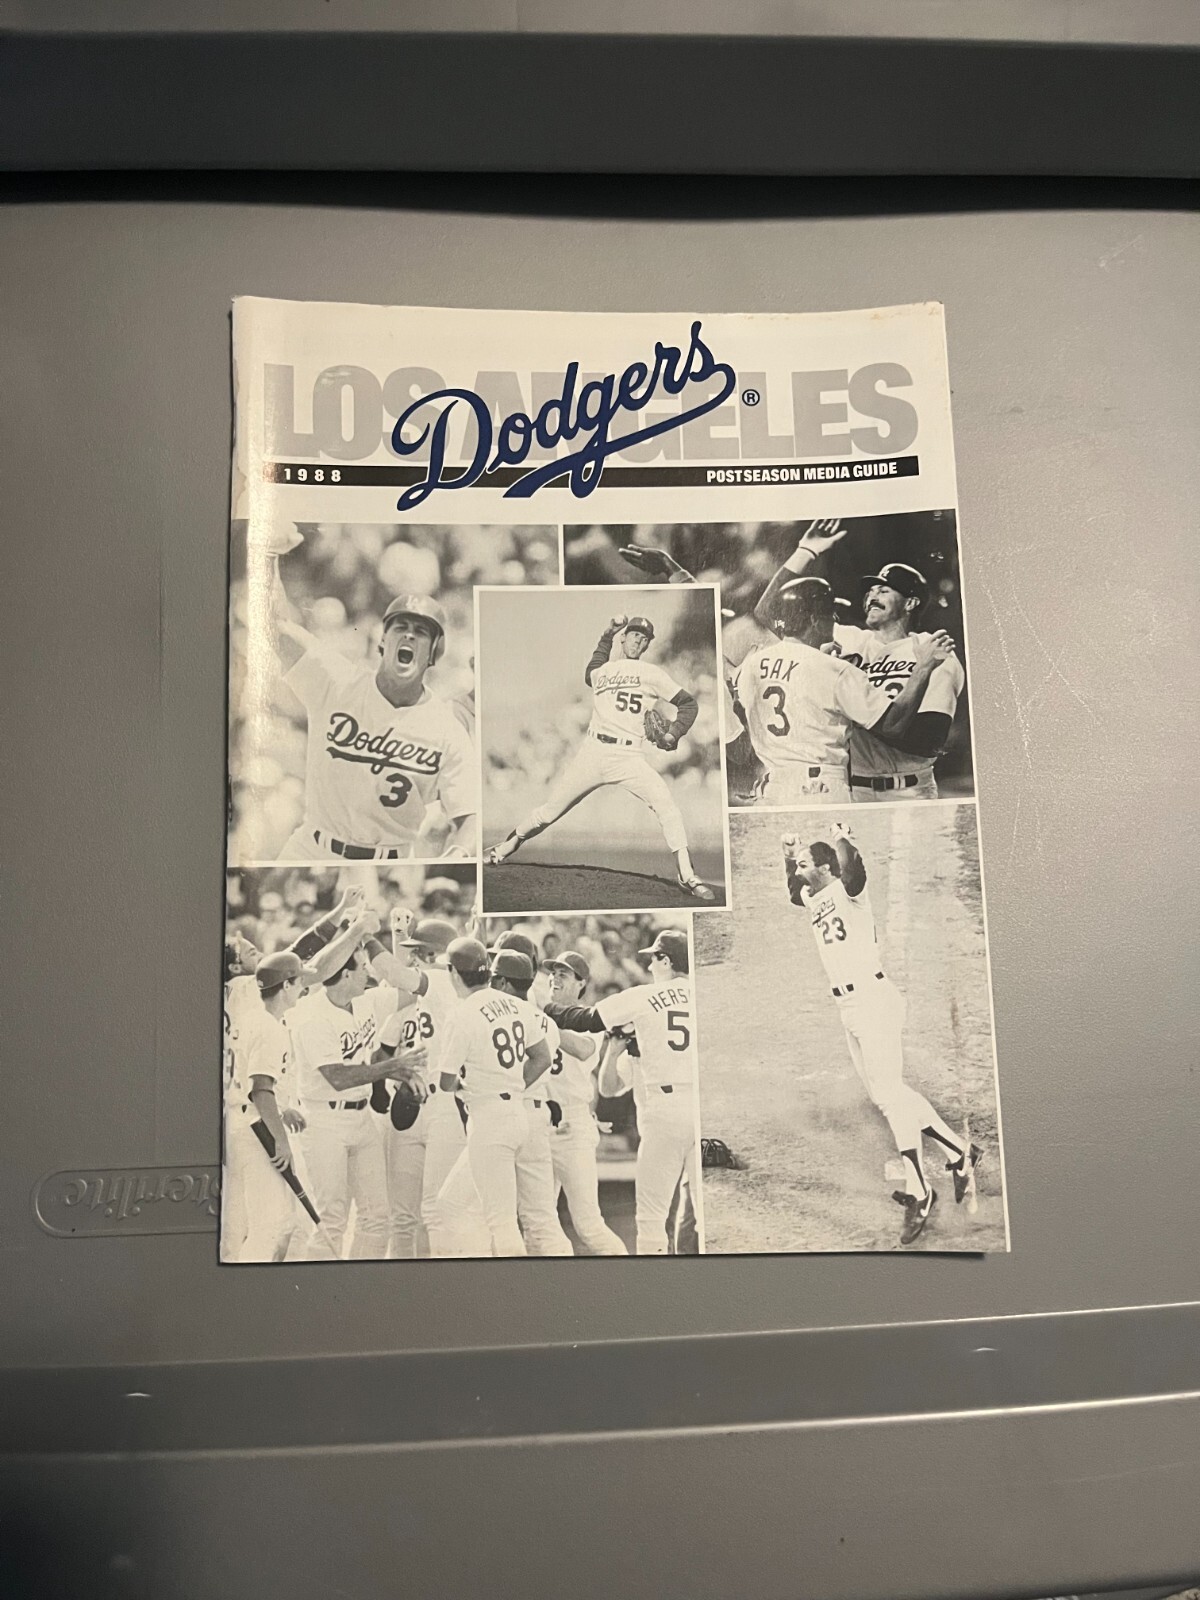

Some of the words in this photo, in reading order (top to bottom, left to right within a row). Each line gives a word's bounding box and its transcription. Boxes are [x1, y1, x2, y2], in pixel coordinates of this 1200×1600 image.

[264, 363, 450, 462] LOS
[391, 321, 736, 511] Dodgers
[284, 468, 341, 482] 1988
[706, 469, 800, 483] POSTSEASON
[803, 465, 850, 480] MEDIA
[853, 462, 897, 477] GUIDE
[594, 671, 641, 695] Dodgers
[760, 658, 799, 682] SAX
[615, 691, 643, 714] 55
[762, 686, 790, 737] 3
[326, 712, 442, 775] Dodgers
[379, 773, 412, 808] 3
[822, 917, 847, 944] 23
[480, 999, 518, 1022] EVANS
[648, 988, 691, 1013] HERS
[492, 1020, 525, 1069] 88
[667, 1010, 690, 1052] 5
